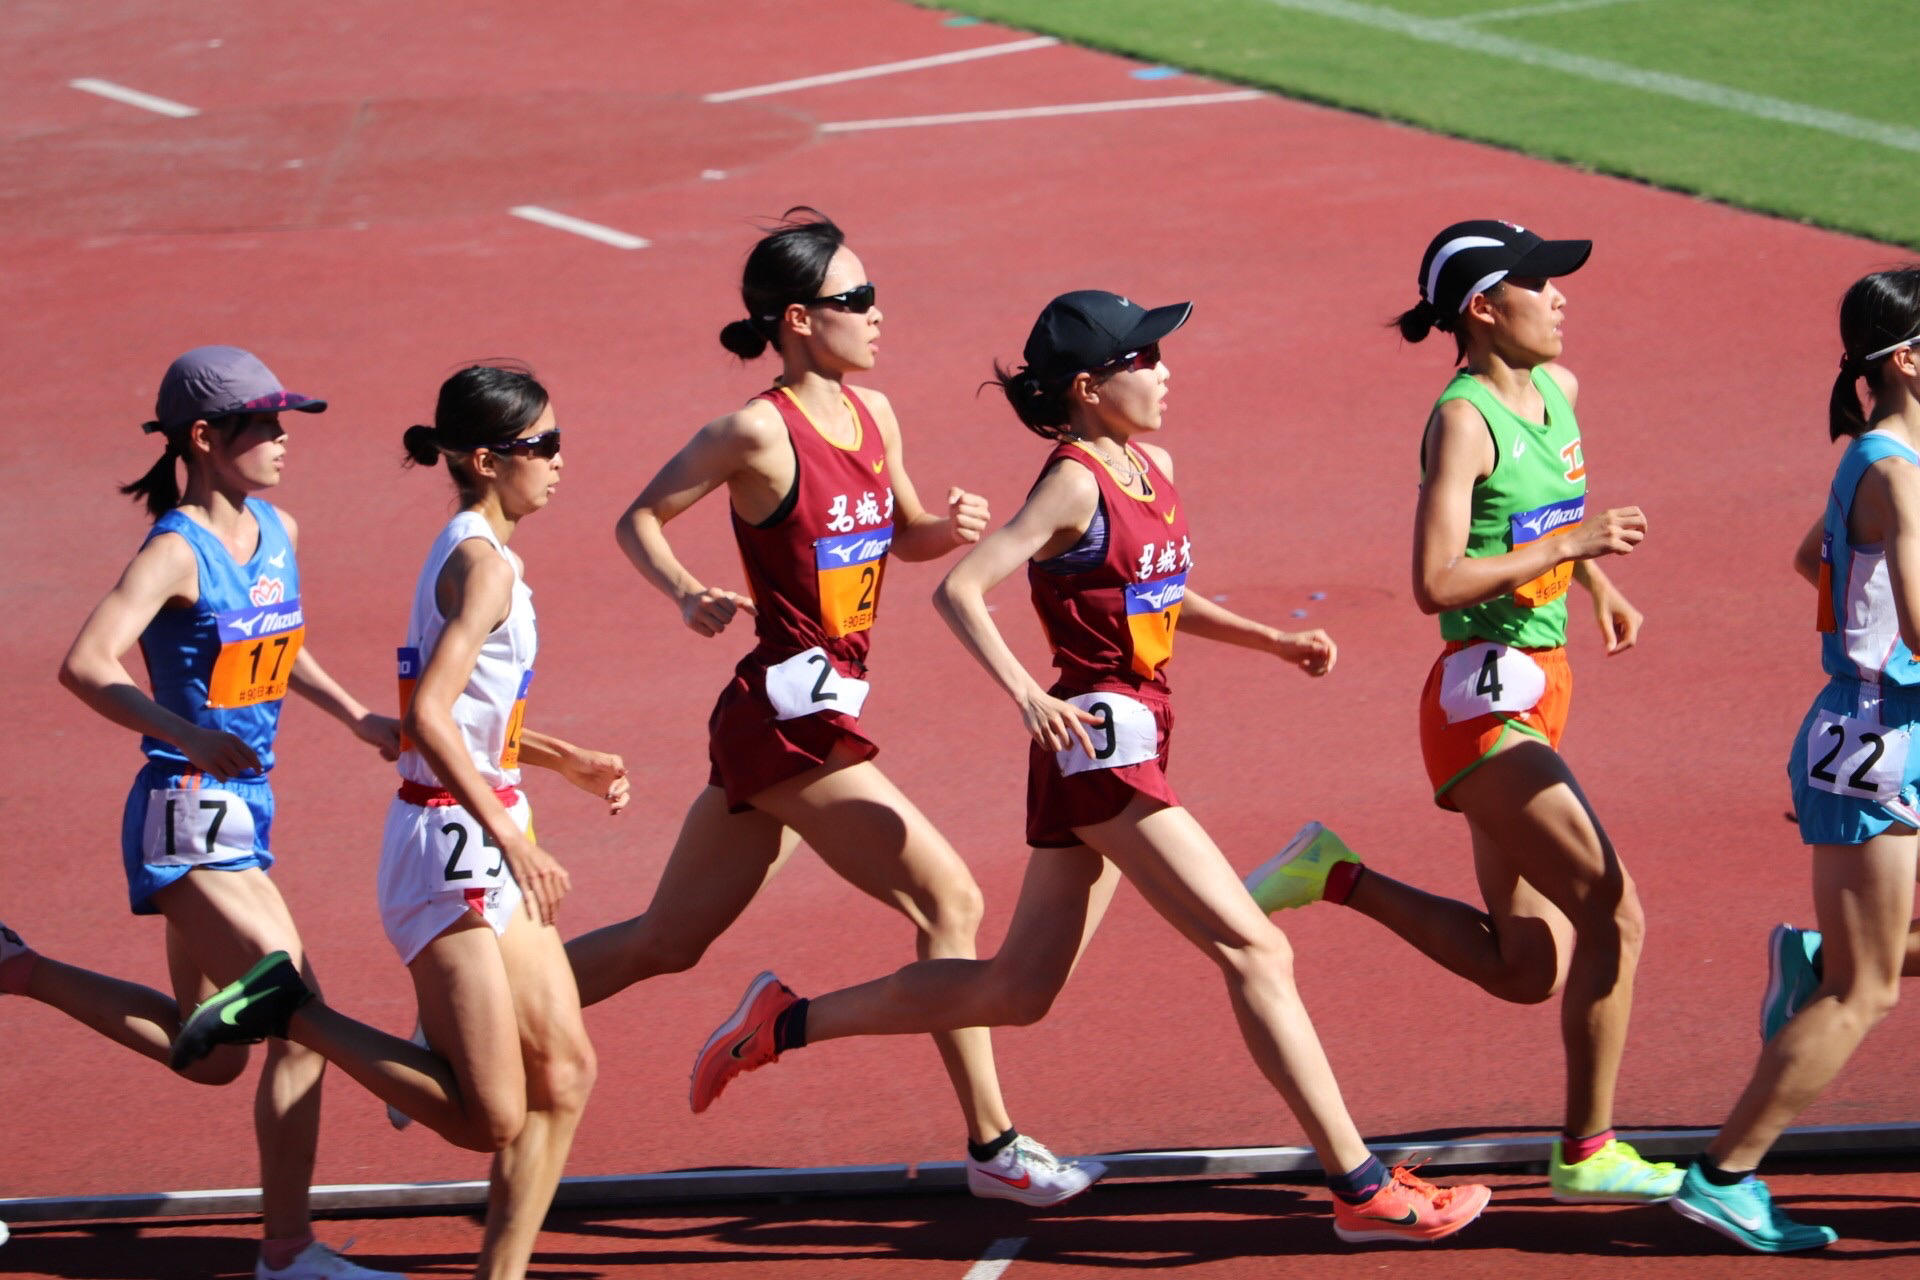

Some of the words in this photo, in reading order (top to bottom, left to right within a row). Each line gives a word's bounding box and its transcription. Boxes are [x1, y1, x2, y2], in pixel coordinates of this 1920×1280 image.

[857, 566, 874, 611] 2
[249, 636, 290, 685] 17
[807, 654, 838, 703] 2
[1476, 649, 1503, 702] 4
[1088, 701, 1116, 760] 9
[1810, 724, 1885, 793] 22
[165, 799, 228, 856] 17
[441, 822, 502, 881] 25
